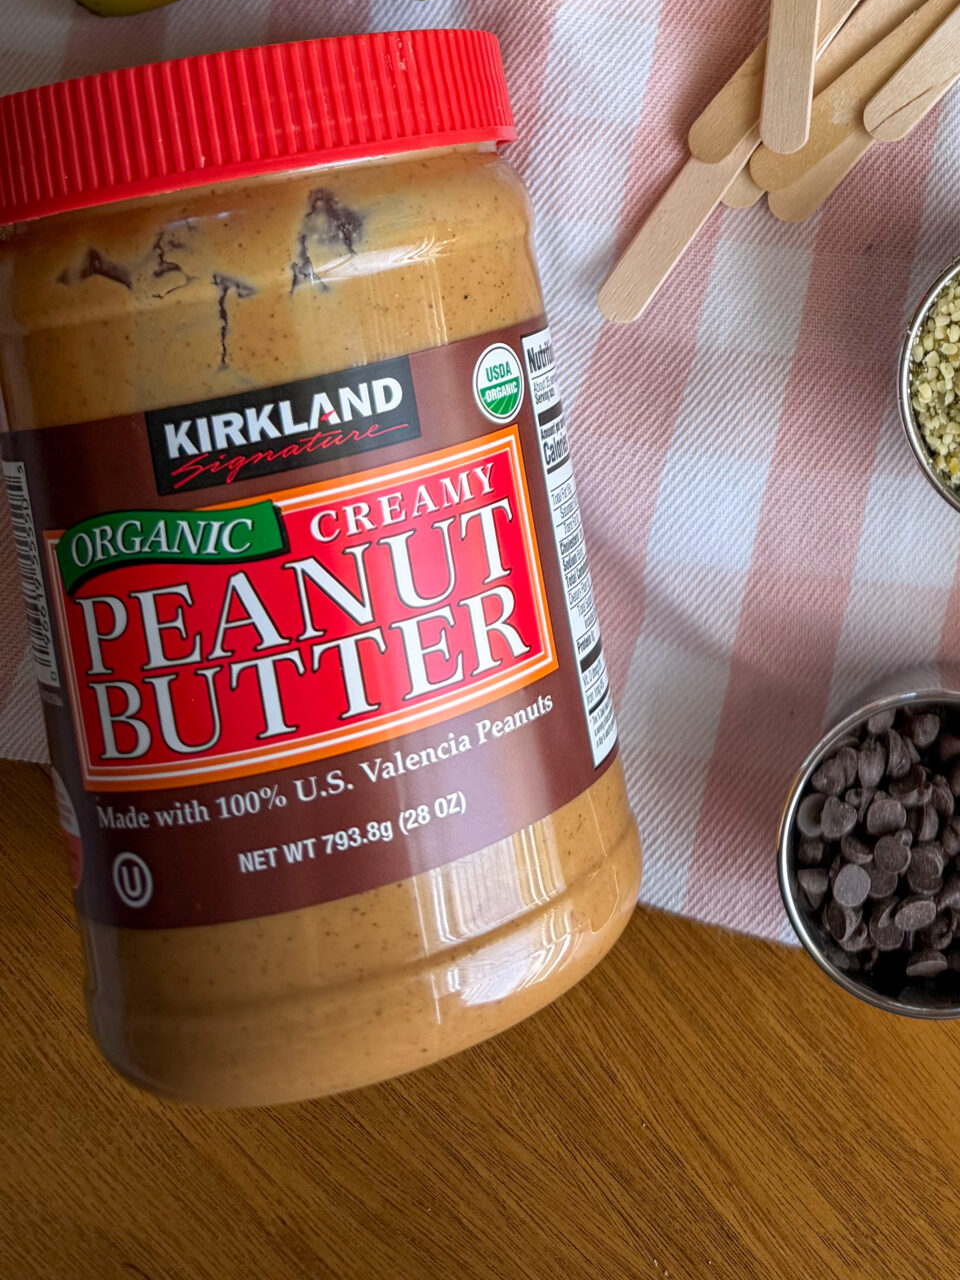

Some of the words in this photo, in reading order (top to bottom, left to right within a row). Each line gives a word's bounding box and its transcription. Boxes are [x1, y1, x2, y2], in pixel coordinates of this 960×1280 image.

[485, 361, 512, 383] USDA
[485, 381, 518, 403] ORGANIC
[164, 376, 404, 459] KIRKLAND
[170, 423, 409, 490] Signature
[71, 518, 255, 569] ORGANIC
[310, 462, 495, 543] CREAMY
[74, 499, 514, 676] PEANUT
[89, 586, 531, 761] BUTTER
[96, 805, 150, 829] Made
[154, 804, 211, 828] with
[216, 786, 287, 821] 100%
[293, 771, 354, 802] U.S.
[359, 734, 473, 783] Valencia
[476, 694, 554, 745] Peanuts
[238, 846, 278, 873] NET
[283, 838, 317, 865] WT
[322, 821, 394, 855] 793.8g
[398, 805, 431, 835] (28
[428, 790, 467, 823] OZ)
